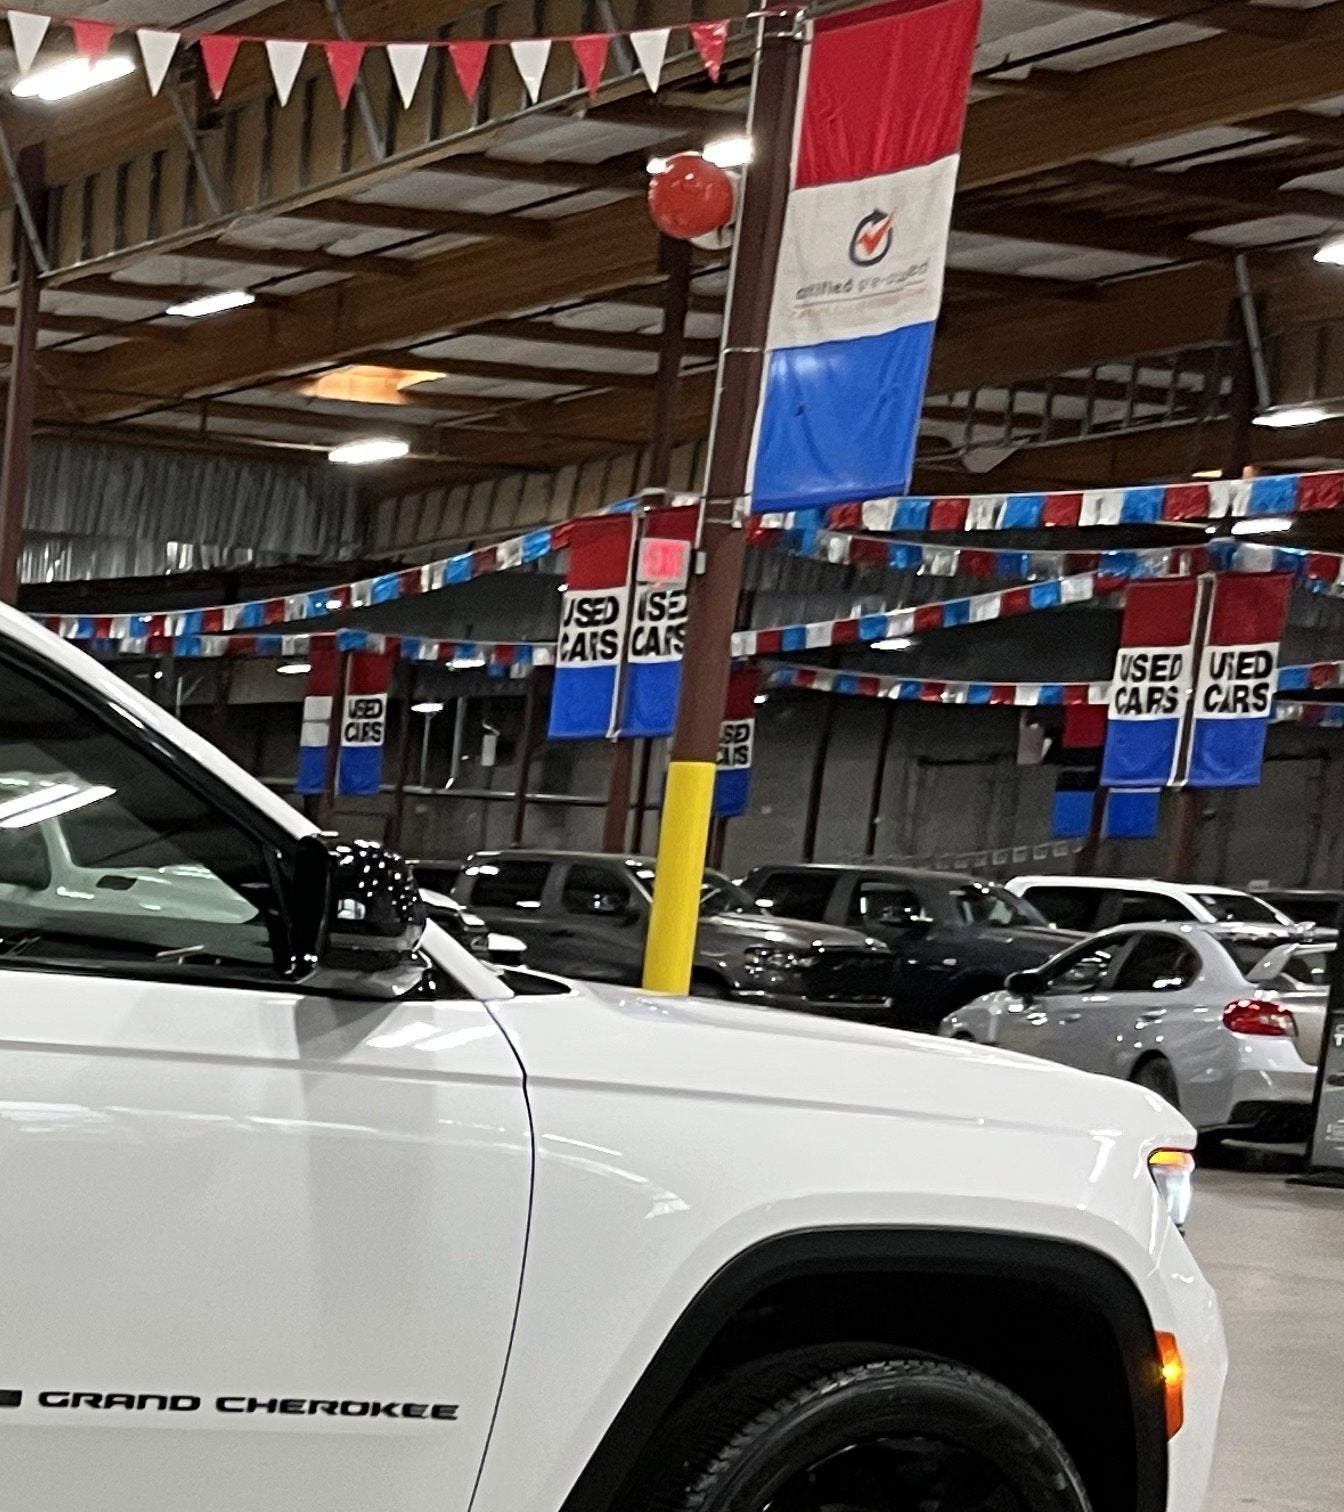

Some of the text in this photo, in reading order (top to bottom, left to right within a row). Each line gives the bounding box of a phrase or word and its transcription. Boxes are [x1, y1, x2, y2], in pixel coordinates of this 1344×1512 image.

[1120, 653, 1183, 683] USED
[1209, 650, 1273, 681] USED
[348, 698, 383, 720] USED
[1114, 685, 1179, 715] CARS
[1203, 682, 1269, 713] CARS
[37, 1389, 459, 1420] GRAND CHEROKEE
